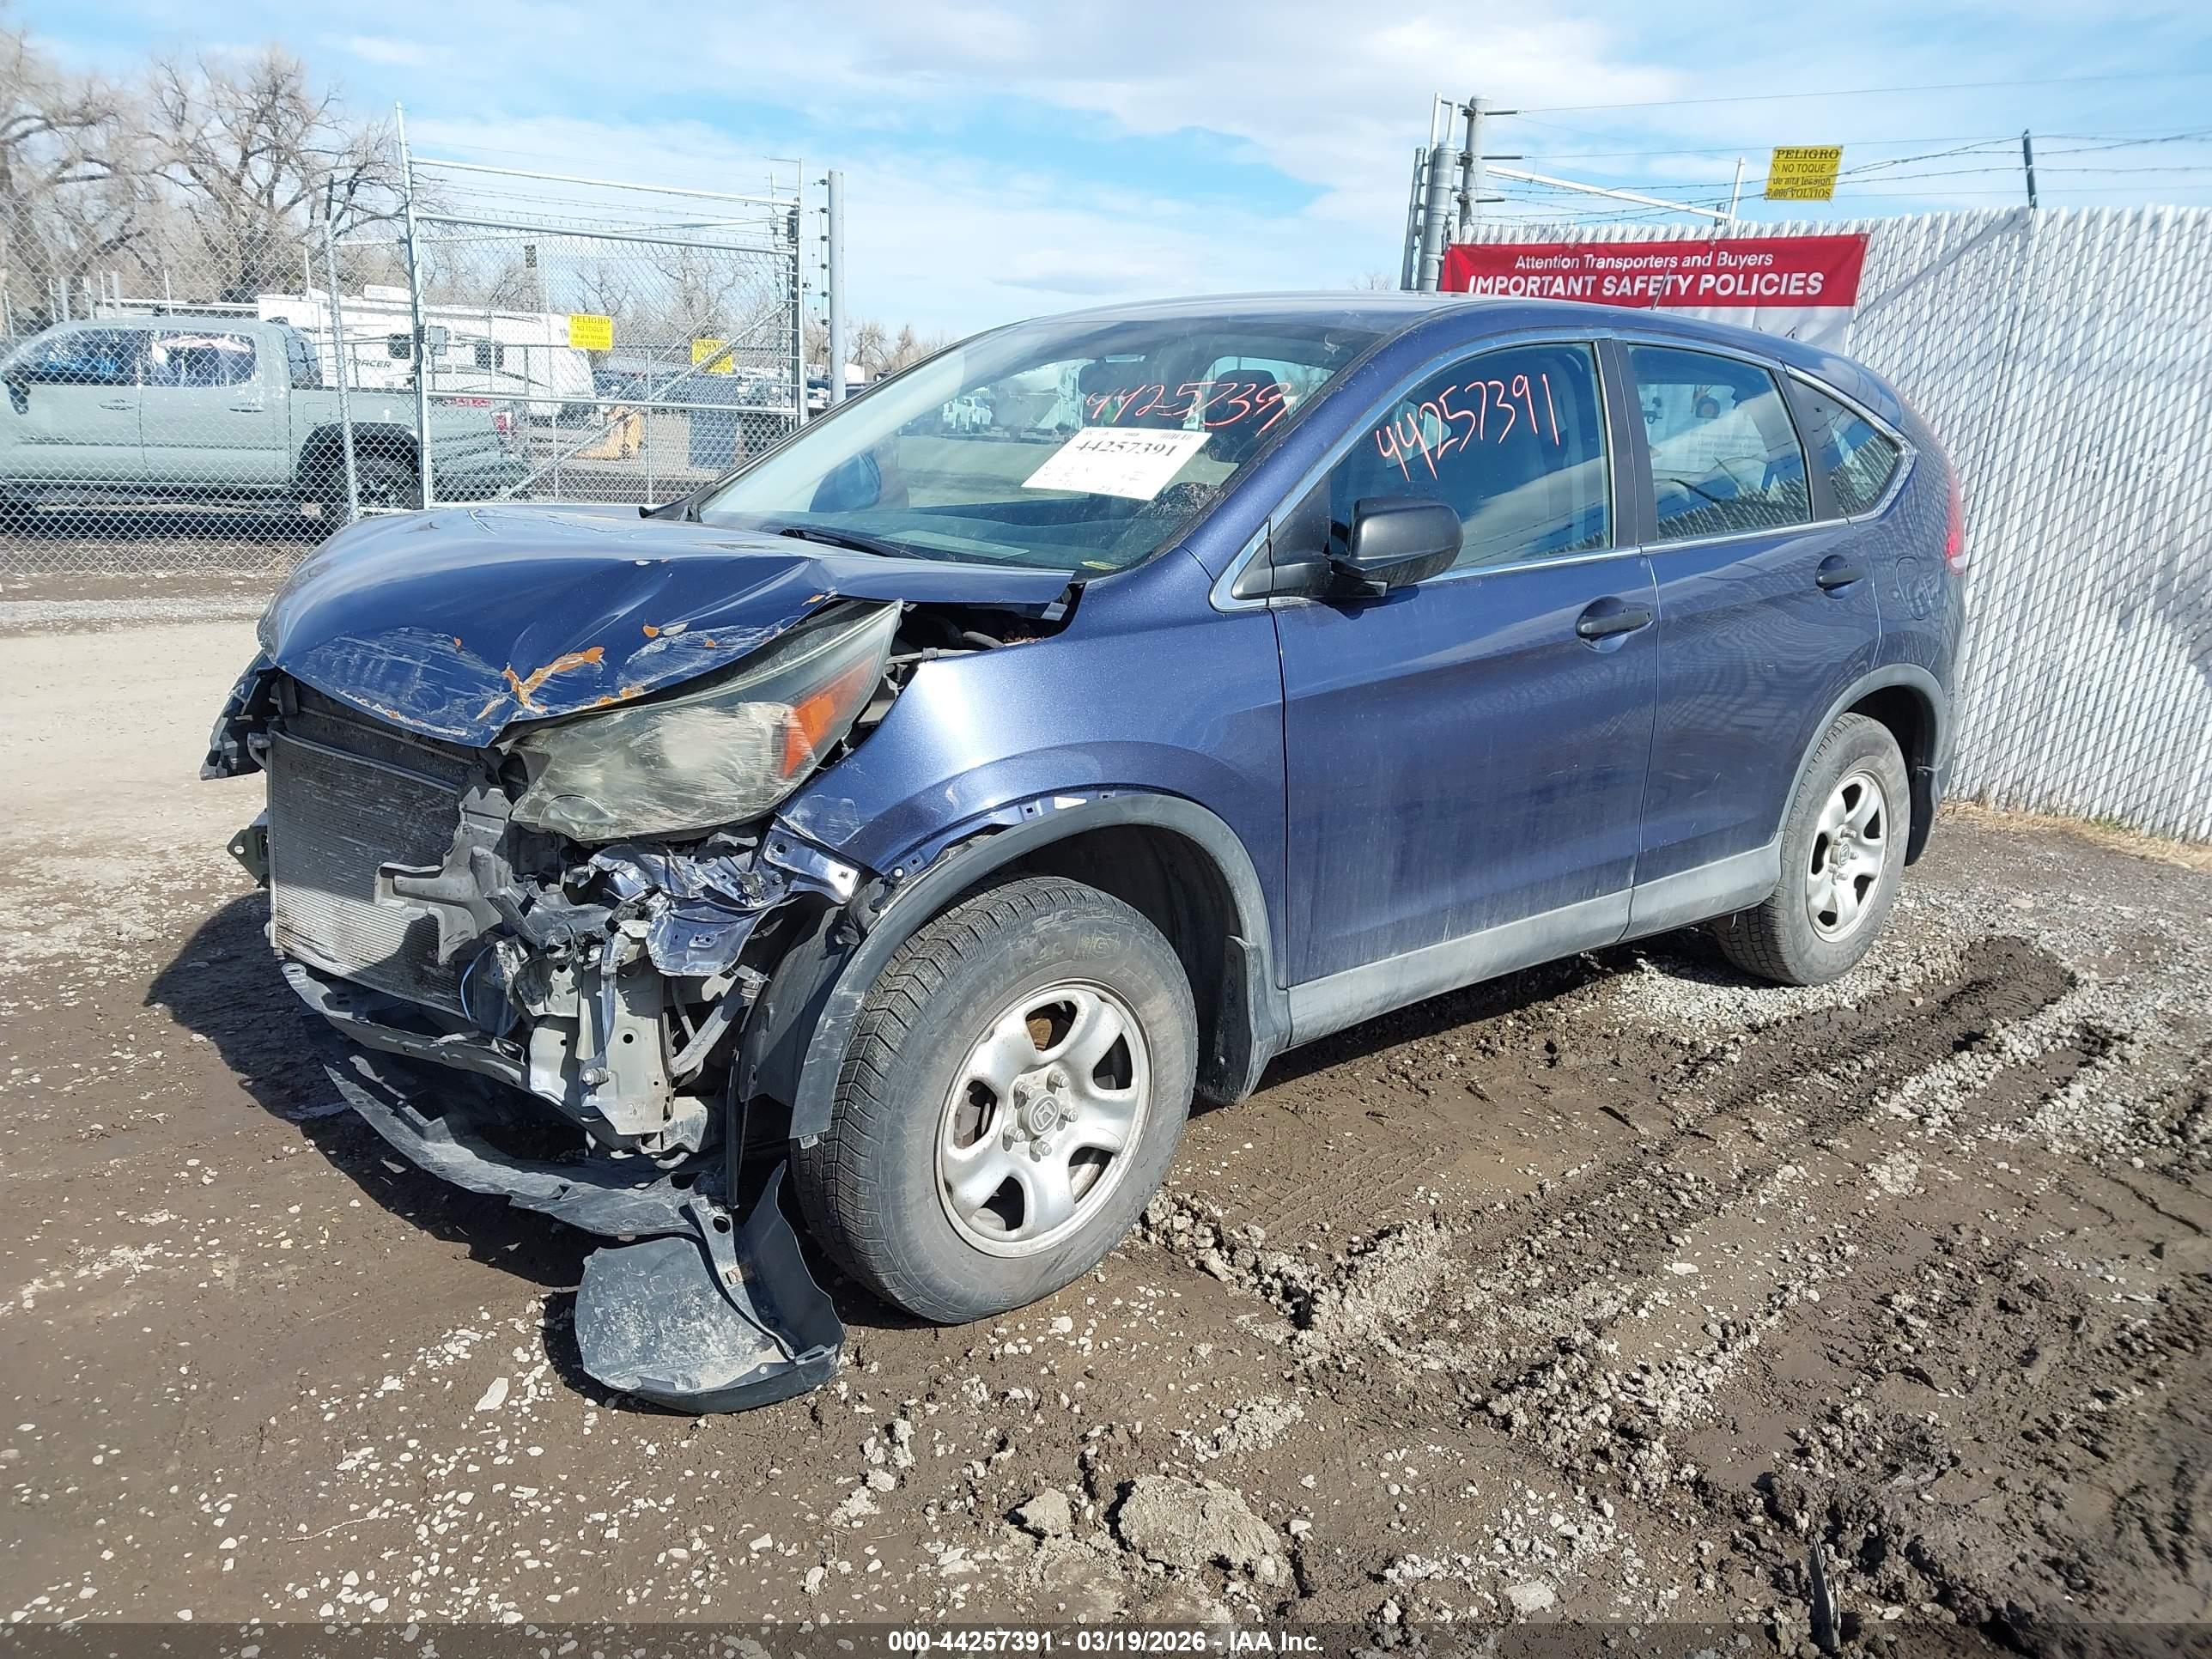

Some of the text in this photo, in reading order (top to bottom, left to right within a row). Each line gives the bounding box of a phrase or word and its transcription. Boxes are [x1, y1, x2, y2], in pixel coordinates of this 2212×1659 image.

[1775, 149, 1839, 160] PELIGRO
[1782, 163, 1826, 173] NO TOQUE
[1790, 188, 1831, 198] VOLTIOS
[1515, 251, 1774, 272] Attention Transporters and Buyers
[1468, 271, 1825, 297] IMPORTANT SAFETY POLICIES
[1376, 373, 1561, 482] 44257391
[1076, 440, 1180, 458] 44257391
